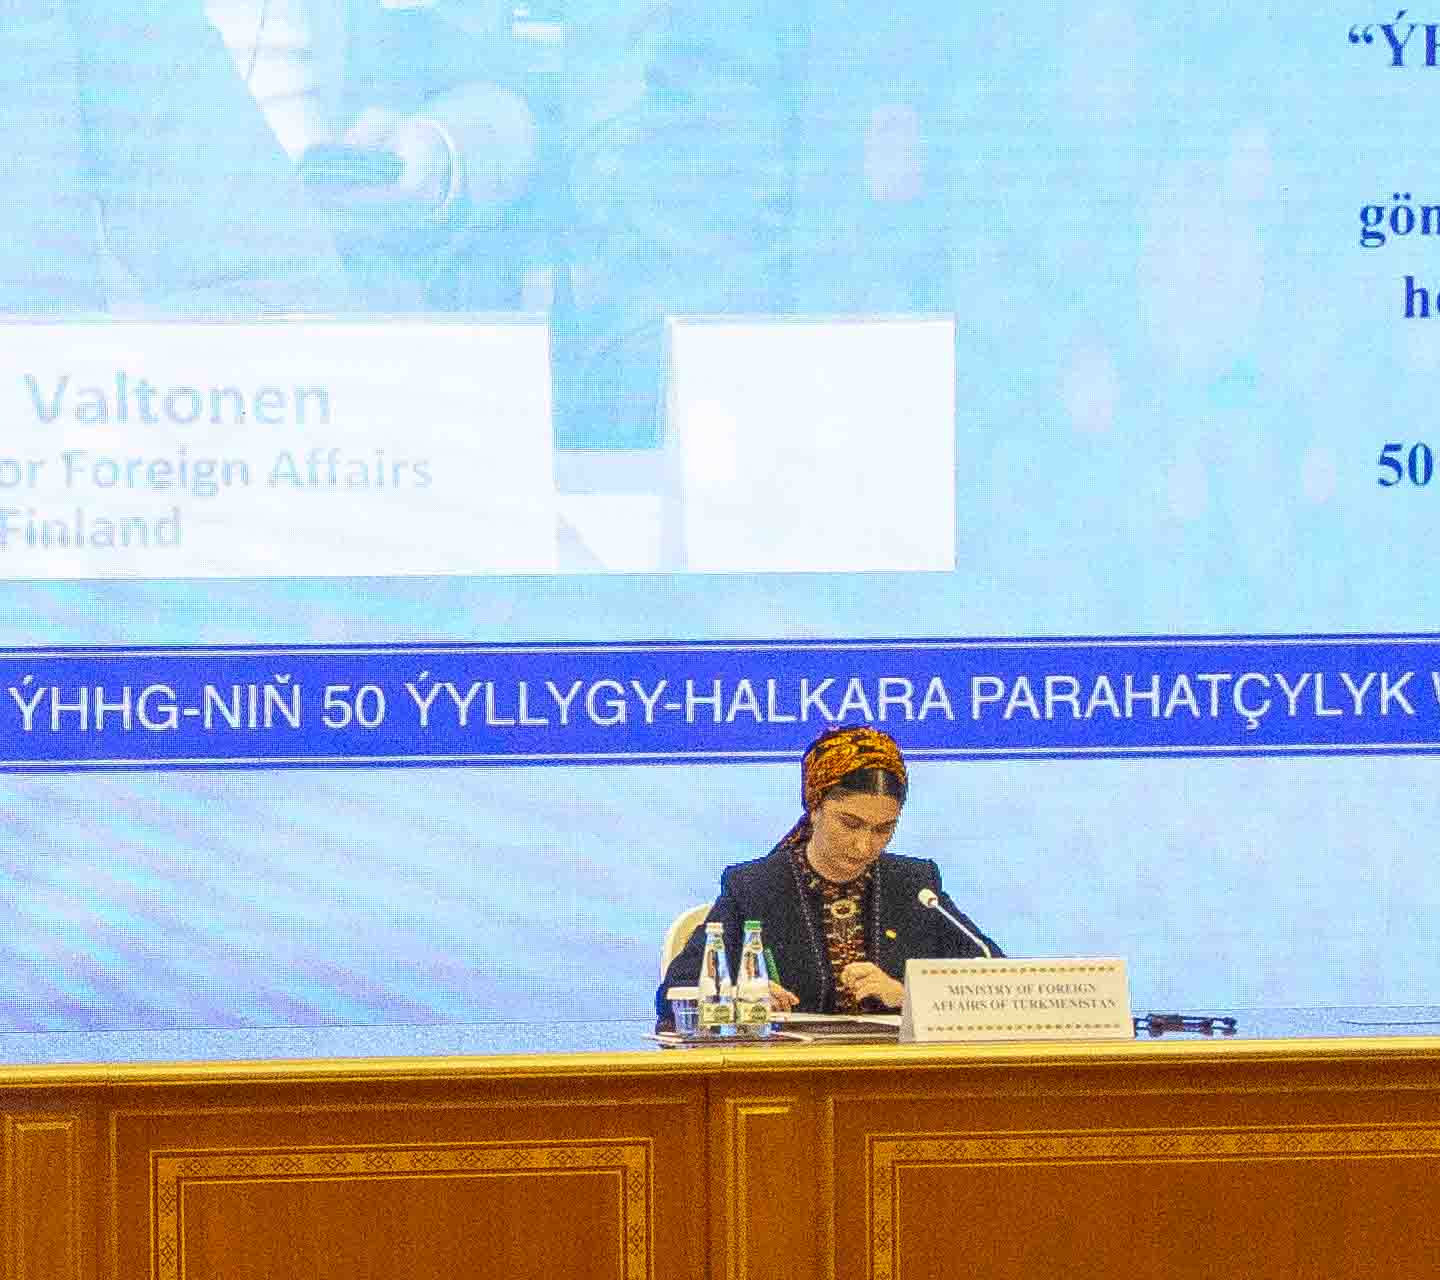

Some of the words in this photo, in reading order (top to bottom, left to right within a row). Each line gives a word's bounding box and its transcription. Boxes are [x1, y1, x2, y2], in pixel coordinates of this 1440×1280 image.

[22, 368, 334, 426] Valtonen
[63, 444, 251, 497] Foreign
[267, 447, 434, 490] Affairs
[1378, 443, 1434, 487] 50
[8, 675, 301, 731] ÝHHG-NIŇ
[323, 684, 386, 729] 50
[406, 671, 954, 728] ÝYLLYGY-HALKARA
[971, 672, 1414, 729] PARAHATÇYLYK
[931, 1000, 987, 1011] AFFAIRS
[990, 999, 1009, 1010] OF
[1012, 998, 1117, 1010] TURKMENISTAN
[946, 983, 1013, 996] MINISTRY
[1016, 983, 1034, 996] OF
[1038, 982, 1097, 994] FOREIGN
